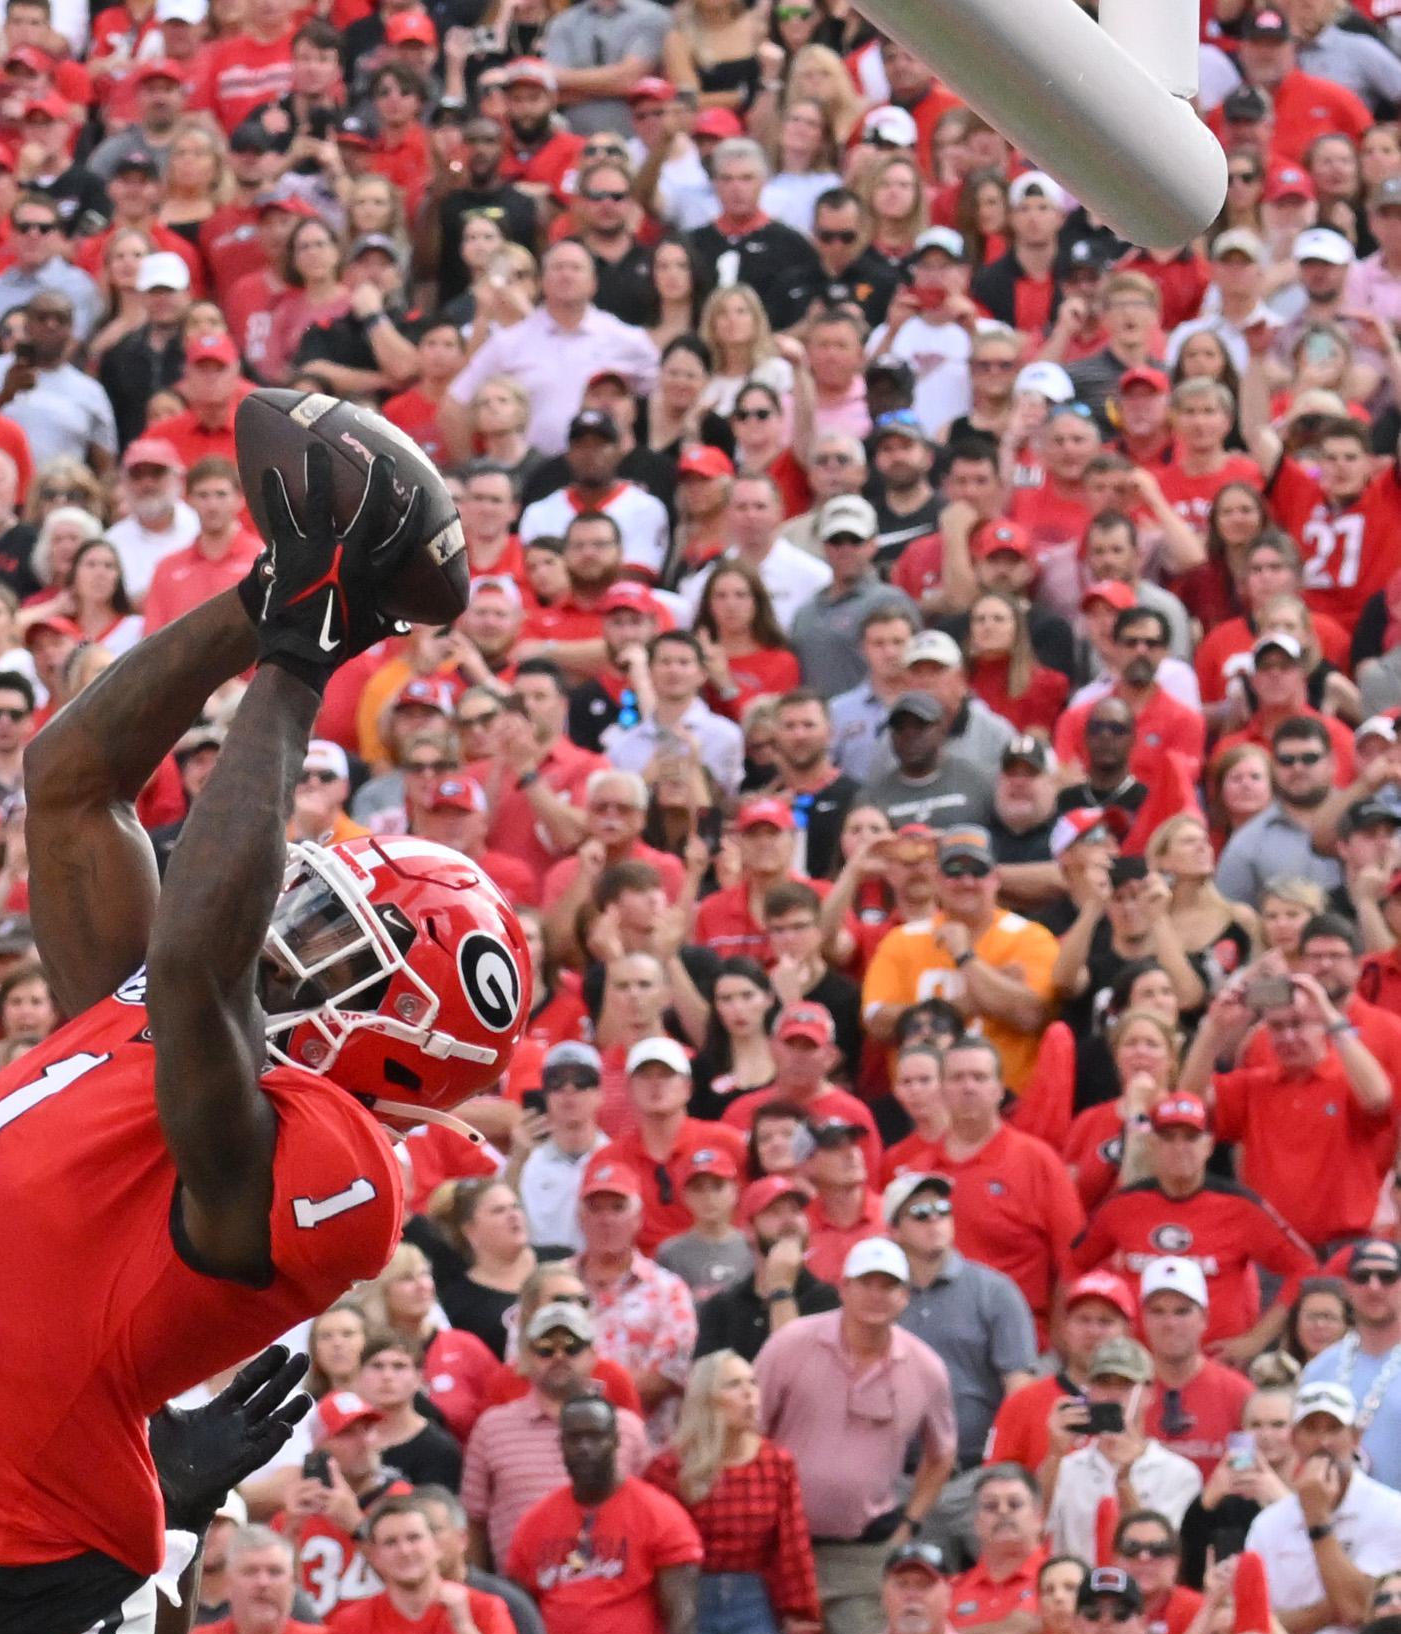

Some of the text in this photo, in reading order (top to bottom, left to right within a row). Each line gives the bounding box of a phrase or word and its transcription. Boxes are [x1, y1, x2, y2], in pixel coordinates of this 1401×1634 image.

[1302, 513, 1366, 589] 27
[456, 930, 522, 1034] G
[292, 1177, 377, 1230] 1
[300, 1534, 387, 1618] 34
